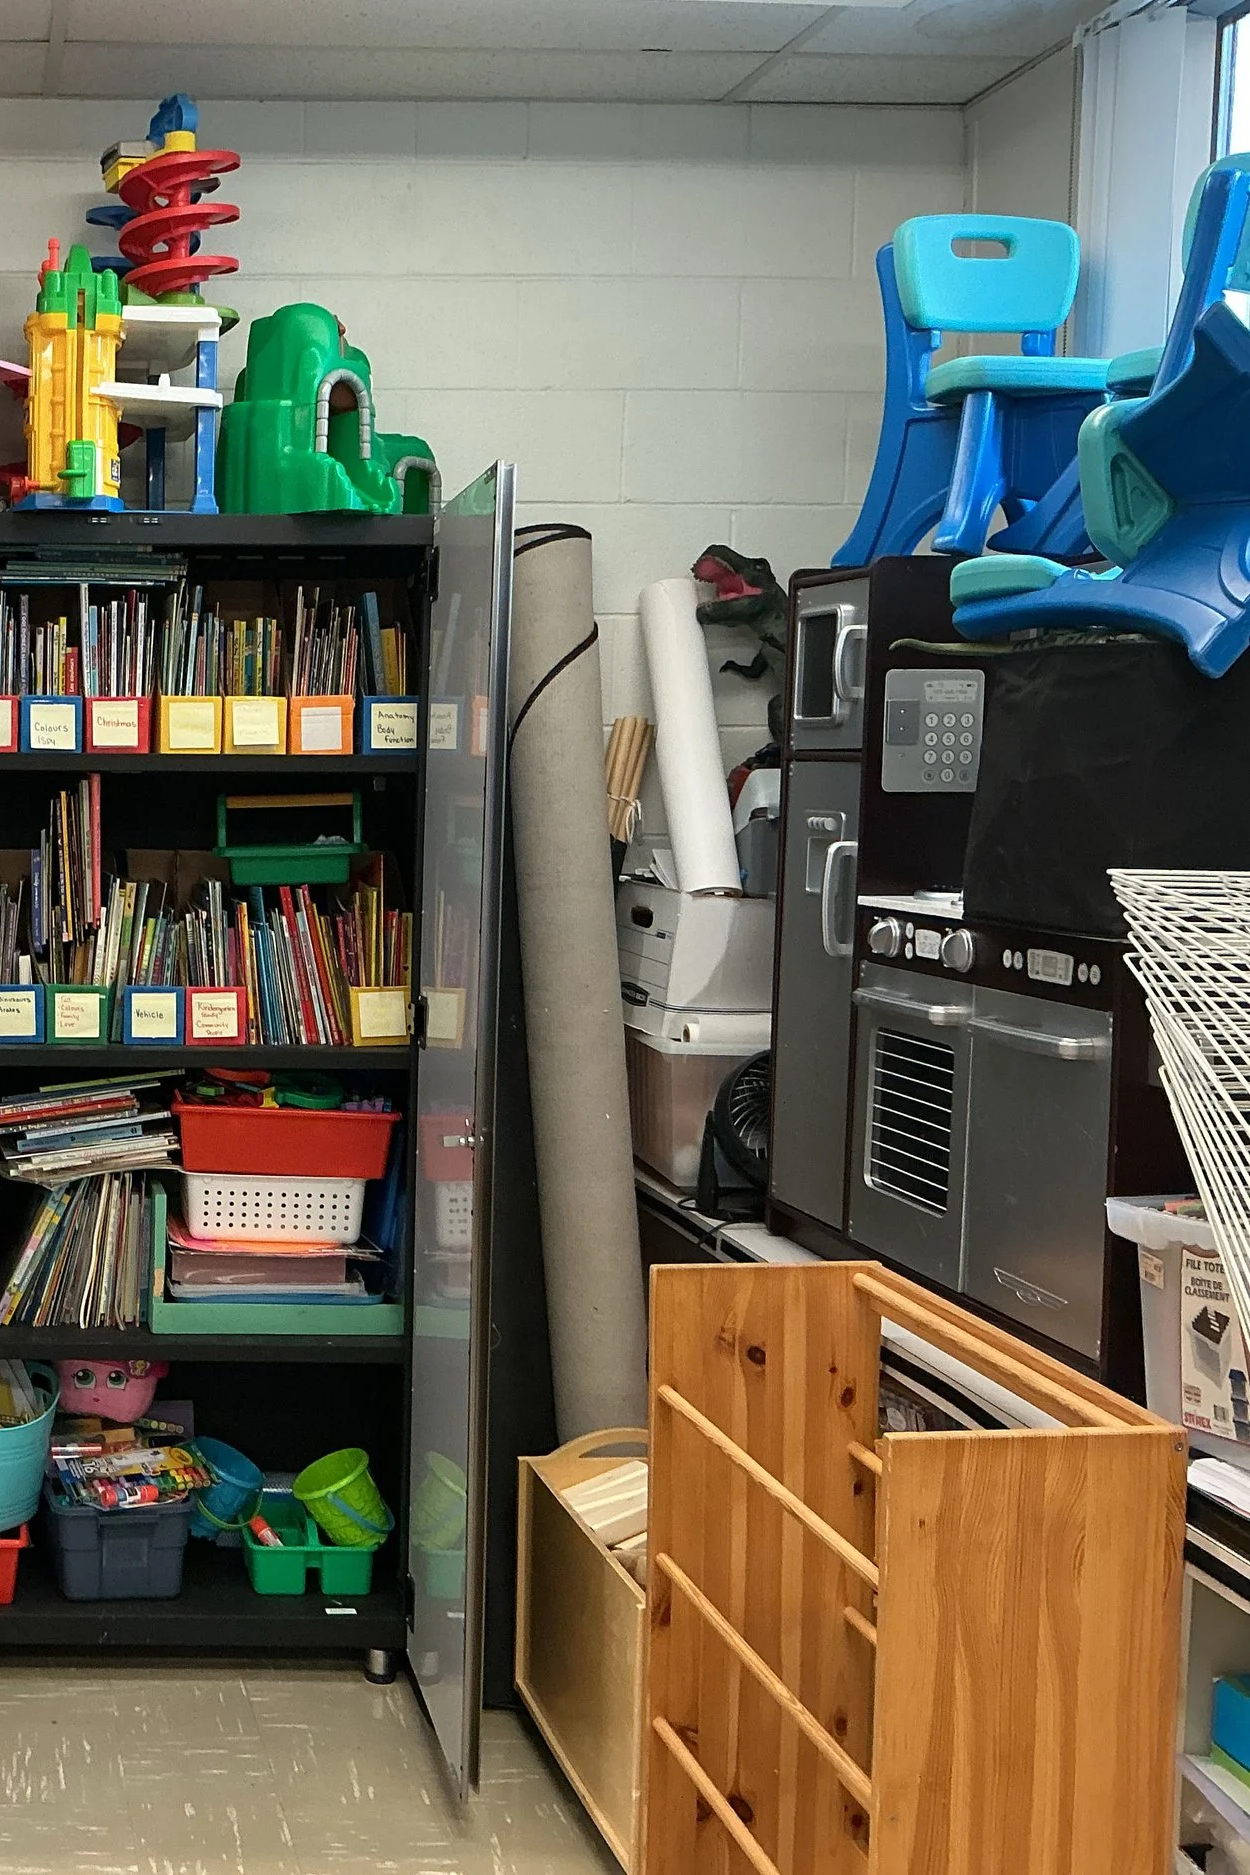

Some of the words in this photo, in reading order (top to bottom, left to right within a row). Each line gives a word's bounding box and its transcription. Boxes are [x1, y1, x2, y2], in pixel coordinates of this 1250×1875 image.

[96, 716, 137, 728] Christmas
[377, 710, 415, 724] Anatomy
[34, 722, 69, 732] Colours
[376, 724, 395, 735] Body
[60, 1004, 84, 1012] Colours
[60, 1012, 80, 1021] Family
[136, 1008, 164, 1020] Vehicle
[60, 1020, 75, 1028] Love
[196, 1020, 228, 1028] Community
[1186, 1258, 1201, 1270] FILE
[1204, 1261, 1225, 1274] TOTE
[1212, 1280, 1223, 1291] DE
[1184, 1286, 1230, 1303] CLASSEMENT
